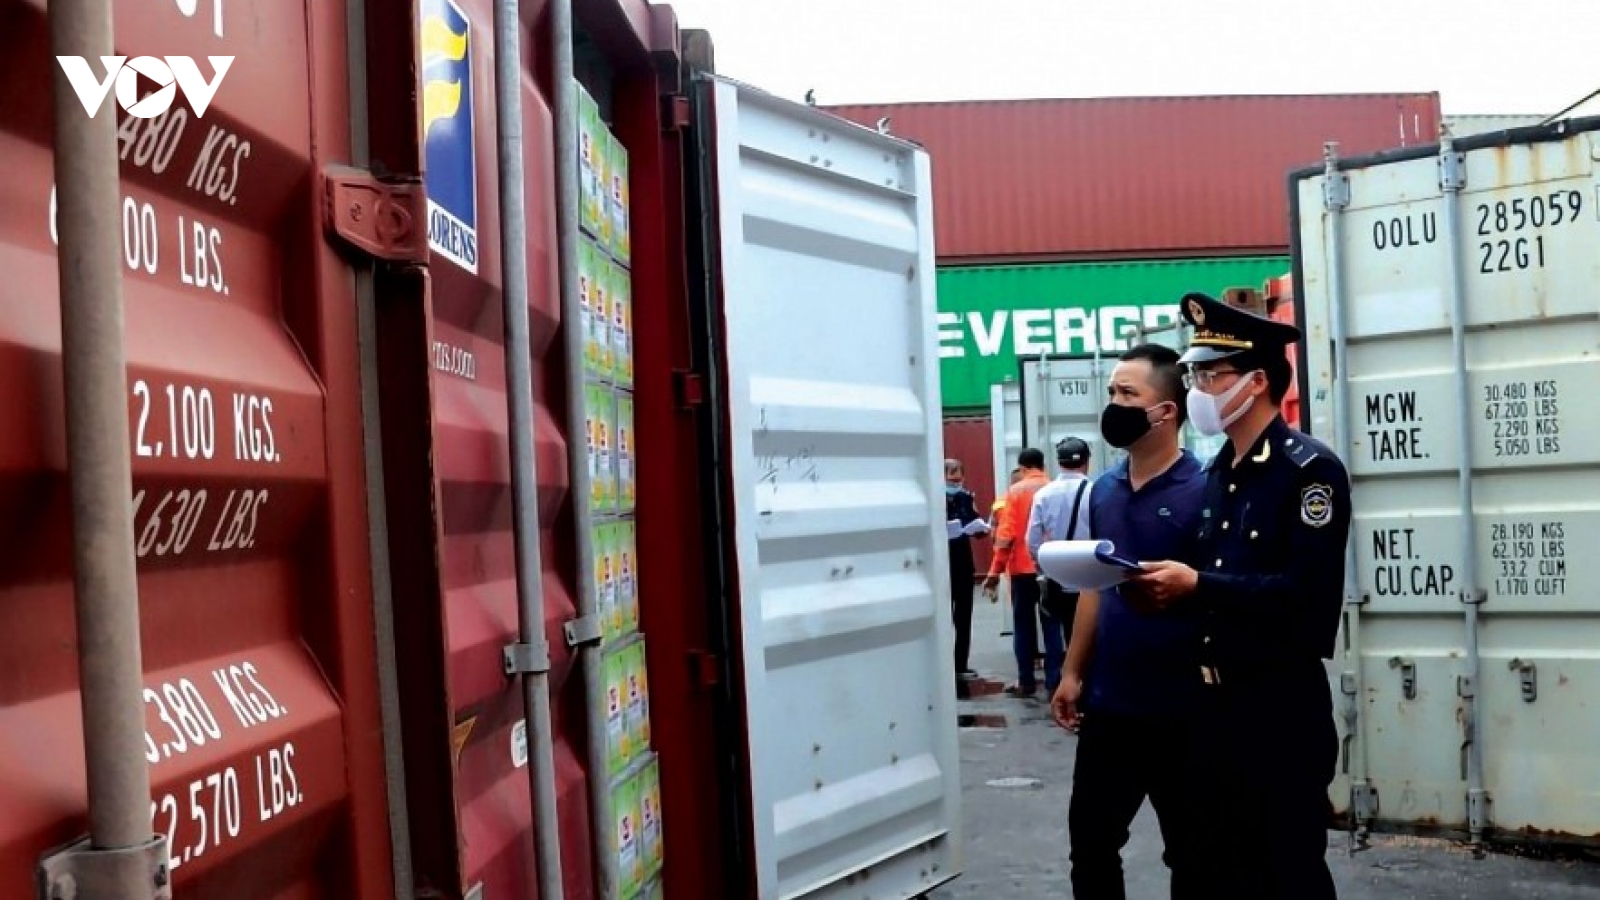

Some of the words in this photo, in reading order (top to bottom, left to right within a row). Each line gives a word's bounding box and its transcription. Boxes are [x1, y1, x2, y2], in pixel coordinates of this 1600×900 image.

[186, 124, 251, 206] KGS.
[1476, 190, 1582, 237] 285059
[122, 196, 159, 275] 00
[178, 215, 229, 295] LBS.
[428, 207, 476, 267] ORENS
[1479, 235, 1545, 273] 22G1
[1059, 381, 1088, 395] VSTU
[1484, 382, 1527, 401] 30.480
[1534, 380, 1558, 398] KGS
[1365, 391, 1423, 426] MGW.
[1485, 400, 1529, 420] 67.200
[1534, 398, 1559, 417] LBS
[233, 392, 280, 463] KGS.
[1367, 427, 1431, 462] TARE.
[1494, 420, 1529, 438] 2.290
[1536, 418, 1559, 436] KGS
[1536, 436, 1561, 455] LBS
[1372, 527, 1420, 561] NET.
[1491, 522, 1534, 541] 28.190
[1541, 521, 1565, 540] KGS
[1491, 541, 1535, 560] 62.150
[1541, 540, 1565, 559] LBS
[211, 661, 289, 729] KGS.
[255, 741, 304, 823] LBS.
